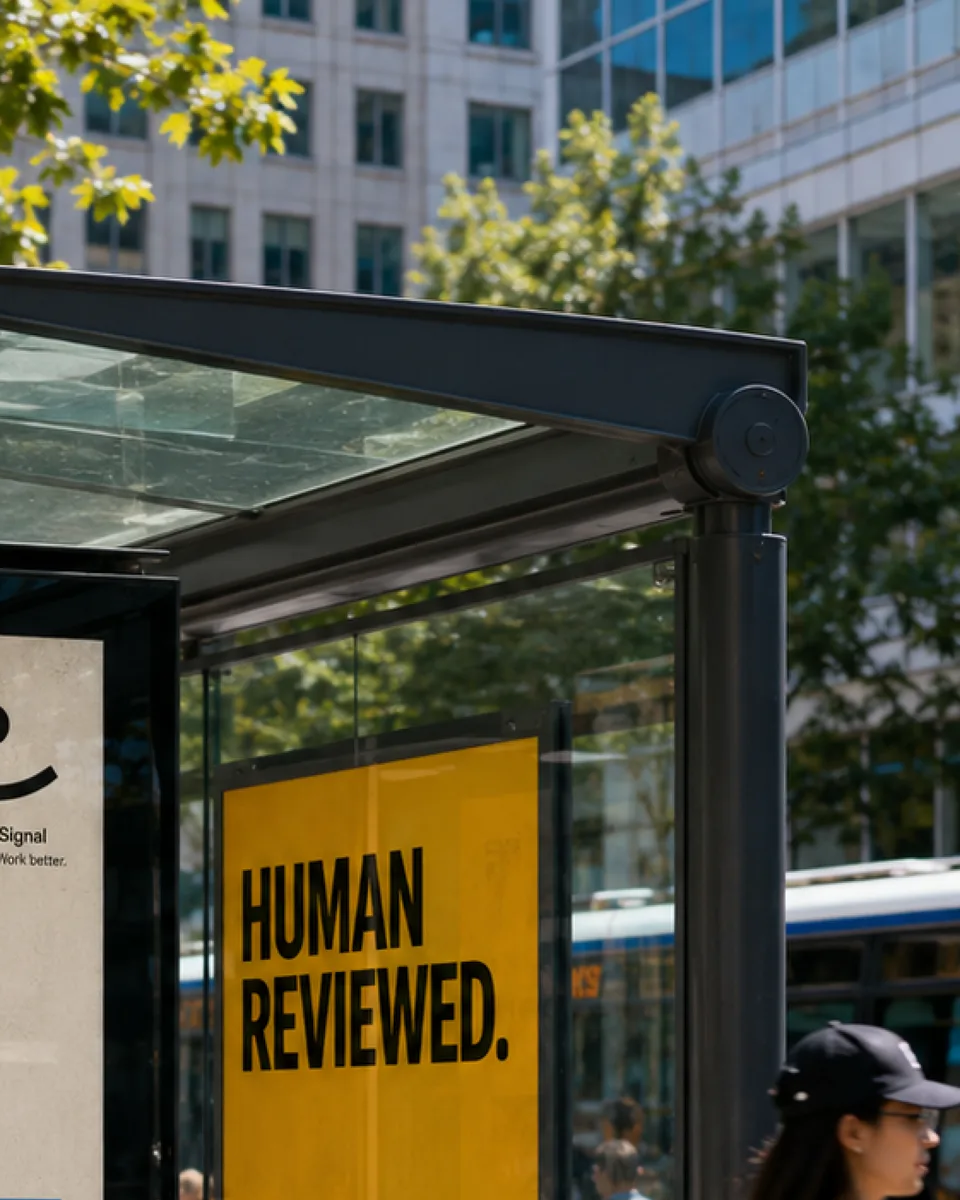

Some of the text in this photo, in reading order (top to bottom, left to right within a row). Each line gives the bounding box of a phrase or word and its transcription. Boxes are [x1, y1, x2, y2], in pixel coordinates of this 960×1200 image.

[29, 853, 67, 867] better.
[242, 846, 423, 963] HUMAN
[242, 960, 509, 1072] REVIEWED.
